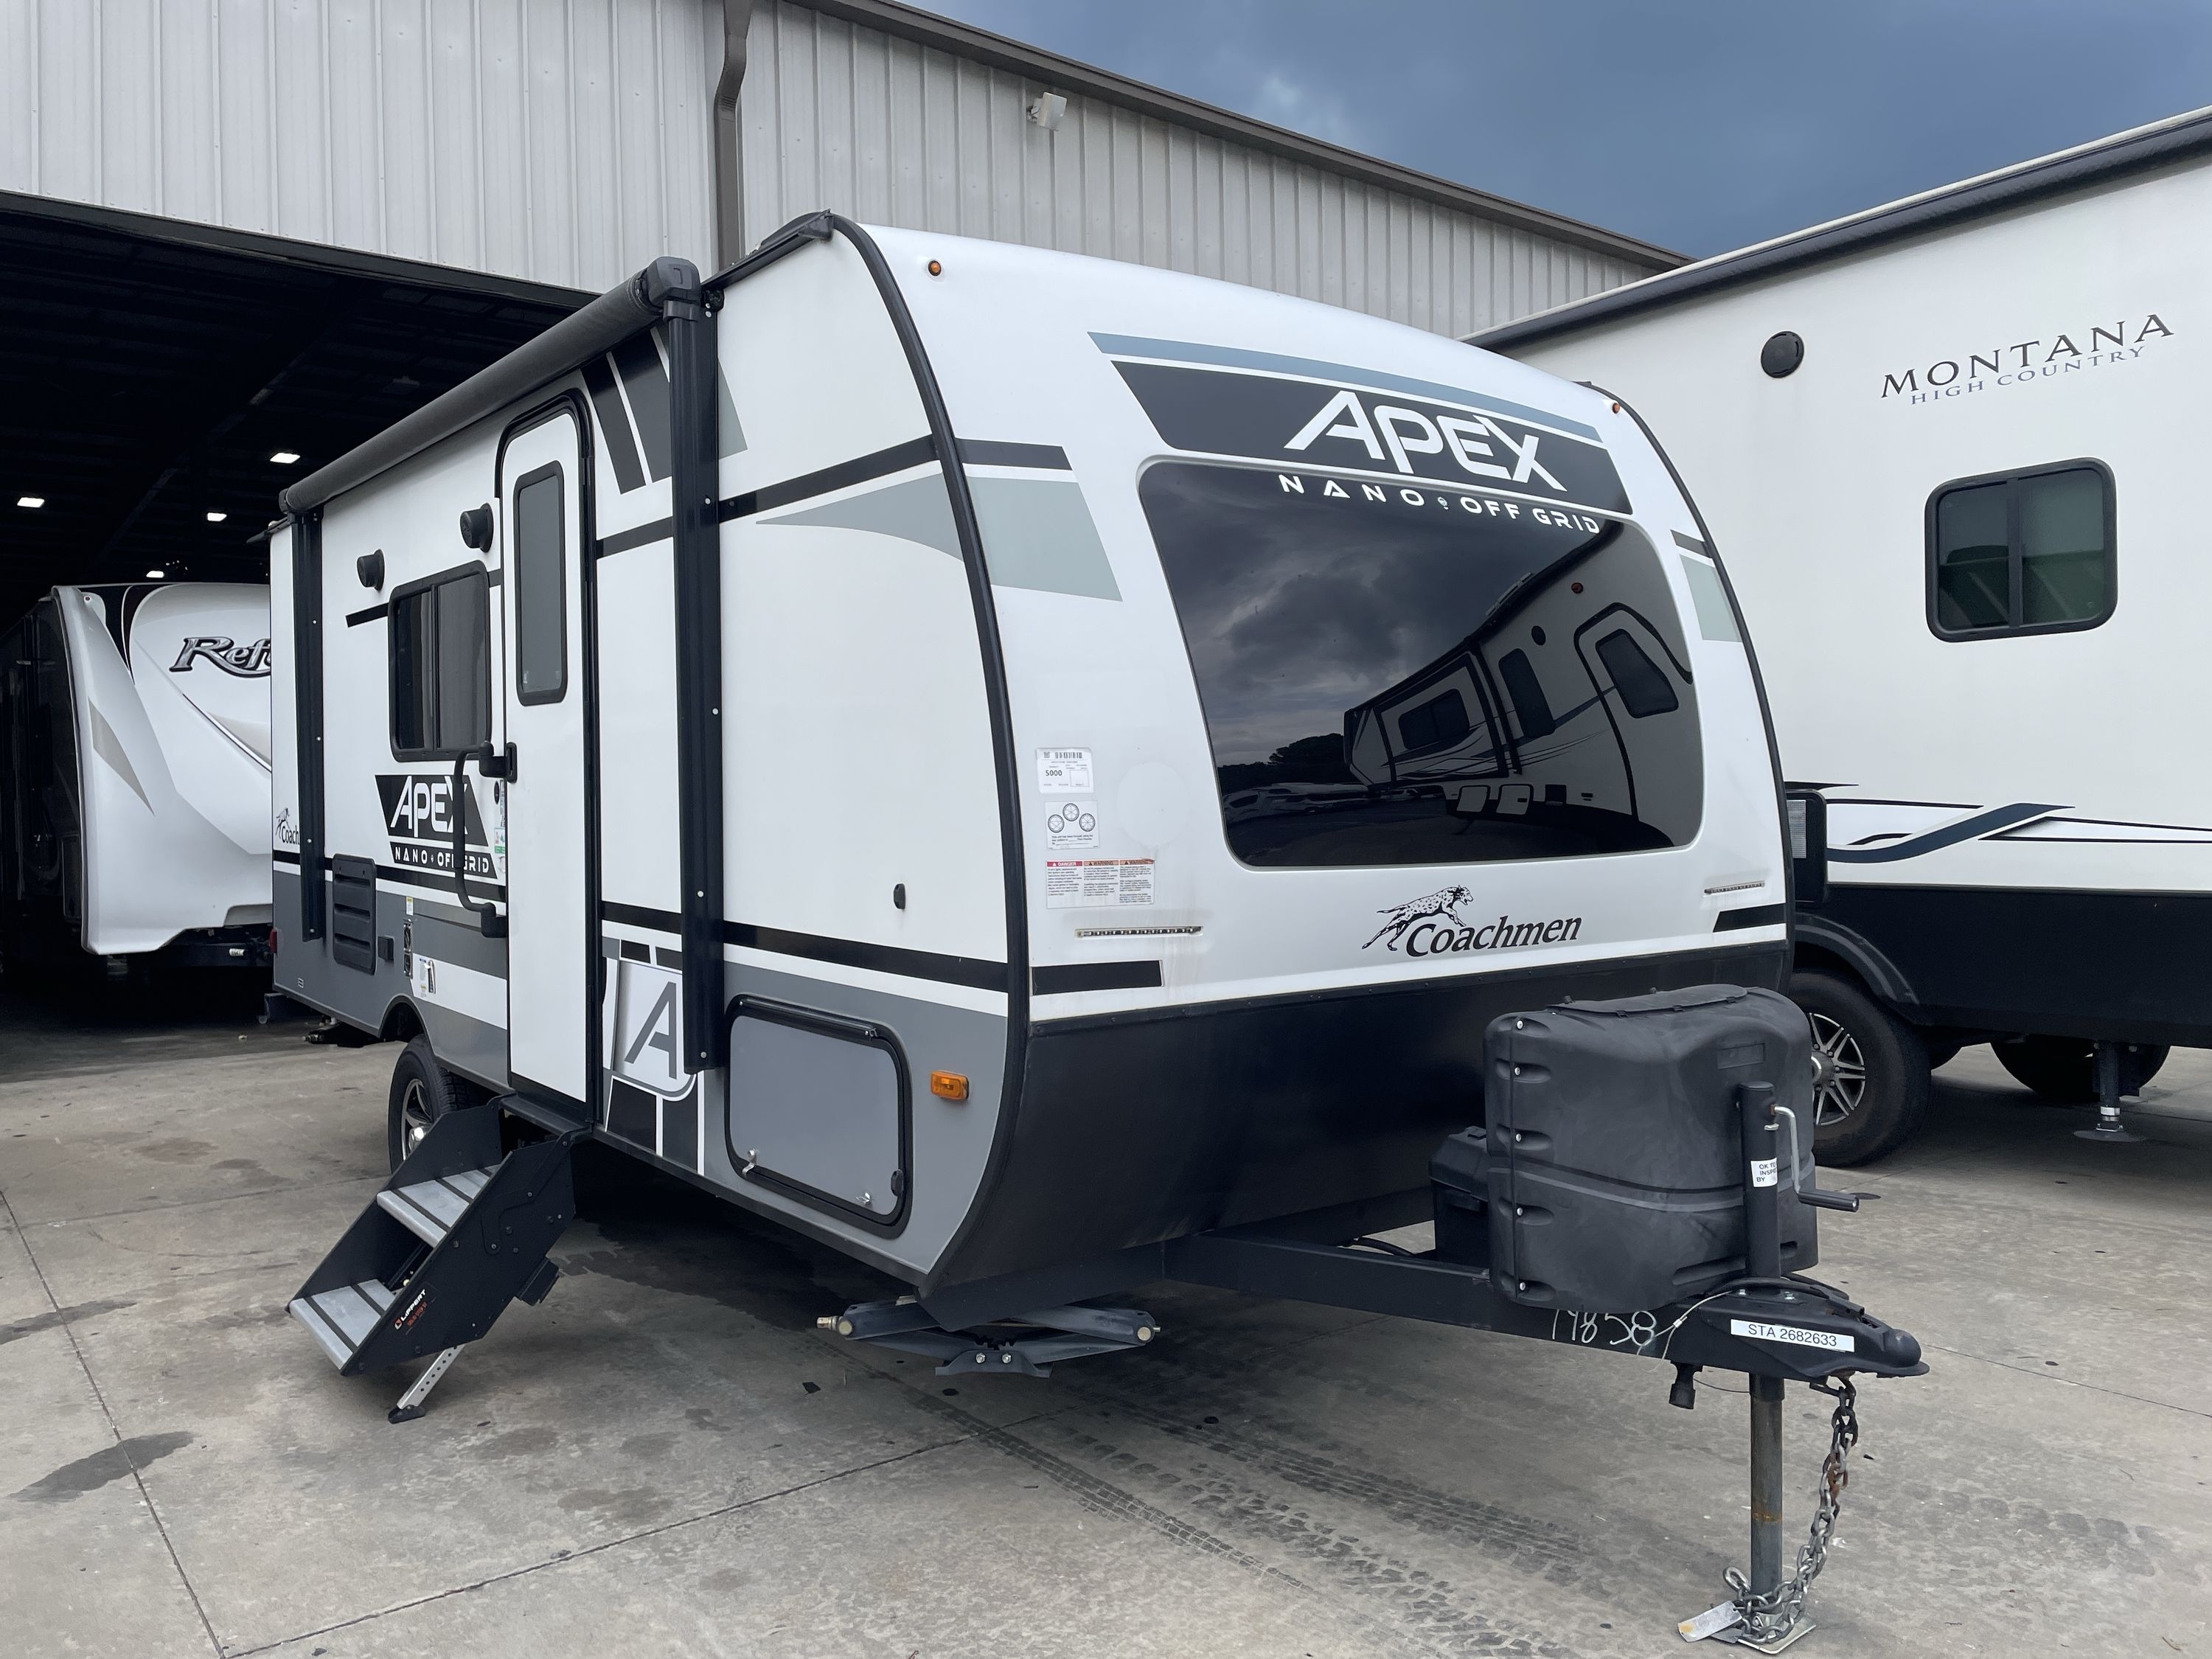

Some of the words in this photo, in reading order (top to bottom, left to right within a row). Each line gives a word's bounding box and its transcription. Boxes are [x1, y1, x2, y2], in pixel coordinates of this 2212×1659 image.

[1879, 313, 2175, 399] MONTANA
[1910, 379, 1985, 406] HIGH
[1995, 345, 2147, 386] COUNTRY
[1283, 389, 1568, 493] APEX
[1277, 473, 1426, 507] NANO
[1459, 495, 1521, 520] OFF
[1531, 507, 1601, 535] GRID
[394, 846, 428, 865] NANO
[1404, 914, 1583, 957] Coachmen
[1748, 1324, 1776, 1338] STA
[1779, 1327, 1837, 1347] 2682633
